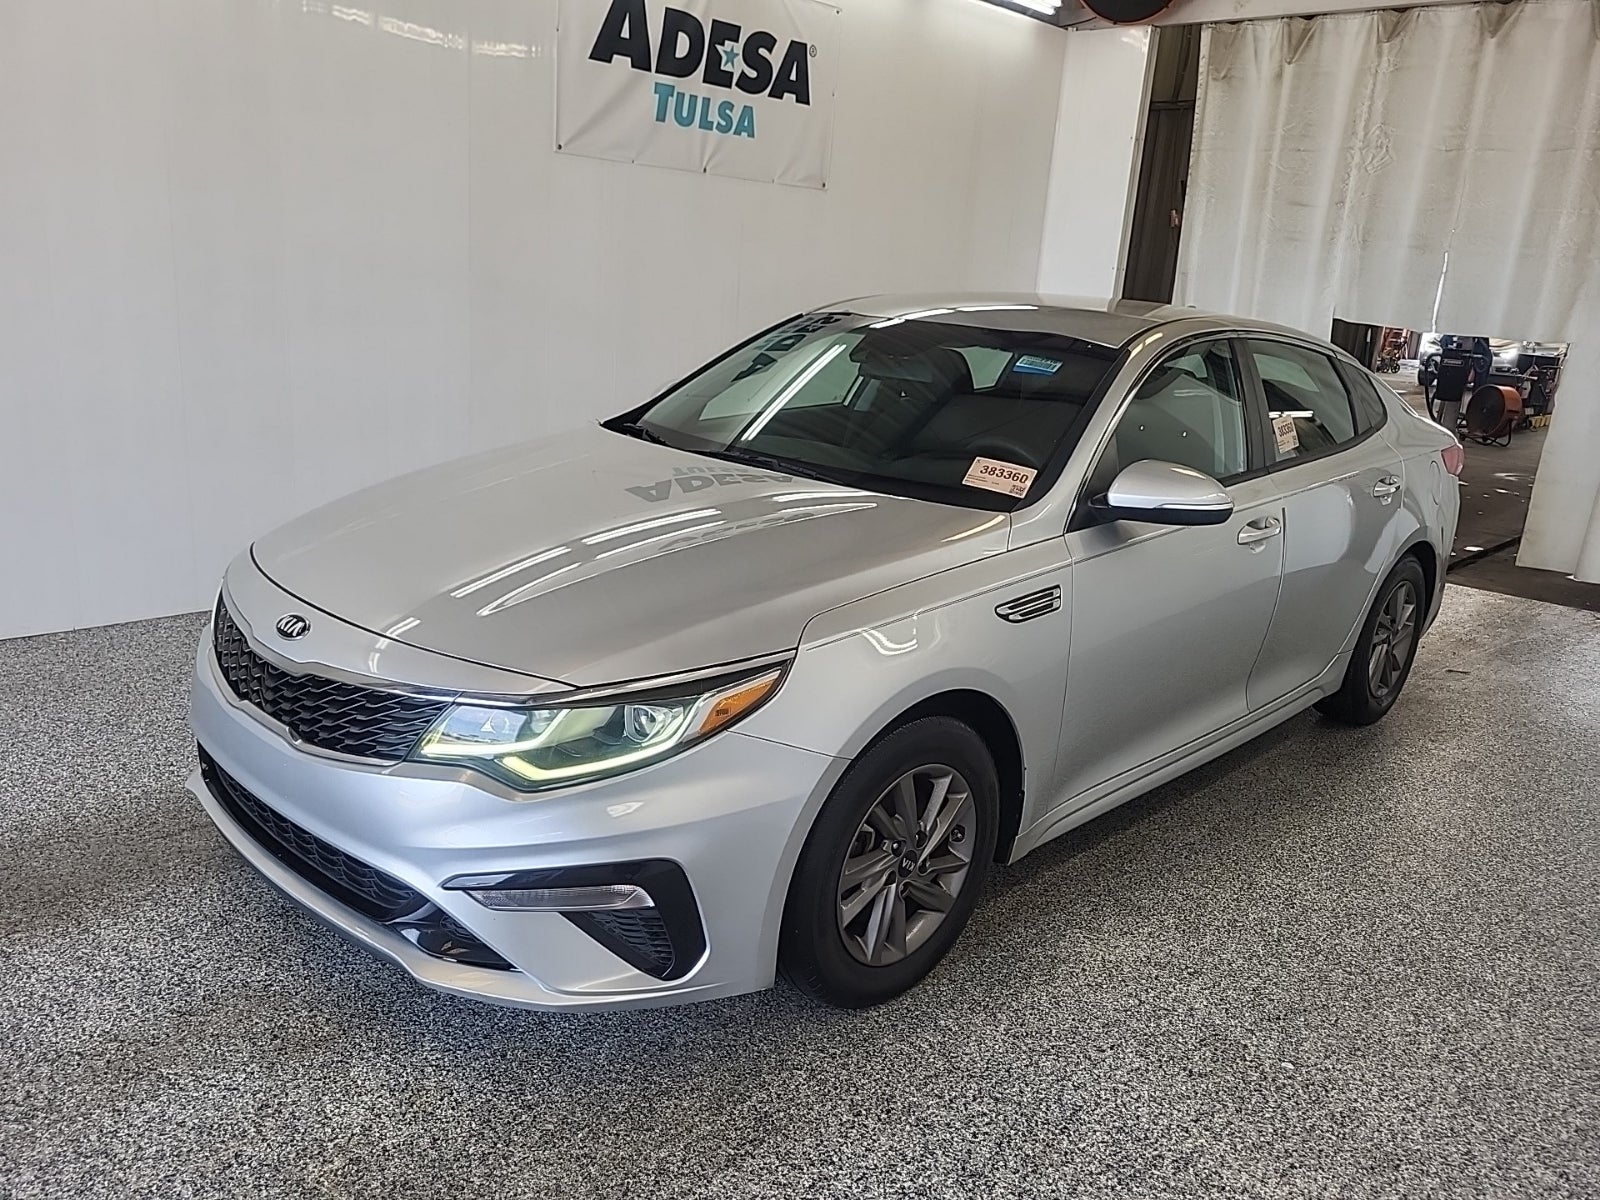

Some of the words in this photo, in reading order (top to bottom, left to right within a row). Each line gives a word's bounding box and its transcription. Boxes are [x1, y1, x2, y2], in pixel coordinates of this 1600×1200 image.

[588, 0, 811, 106] ADESA
[653, 81, 755, 139] TULSA
[980, 465, 1029, 484] 383360
[277, 615, 306, 637] KIA
